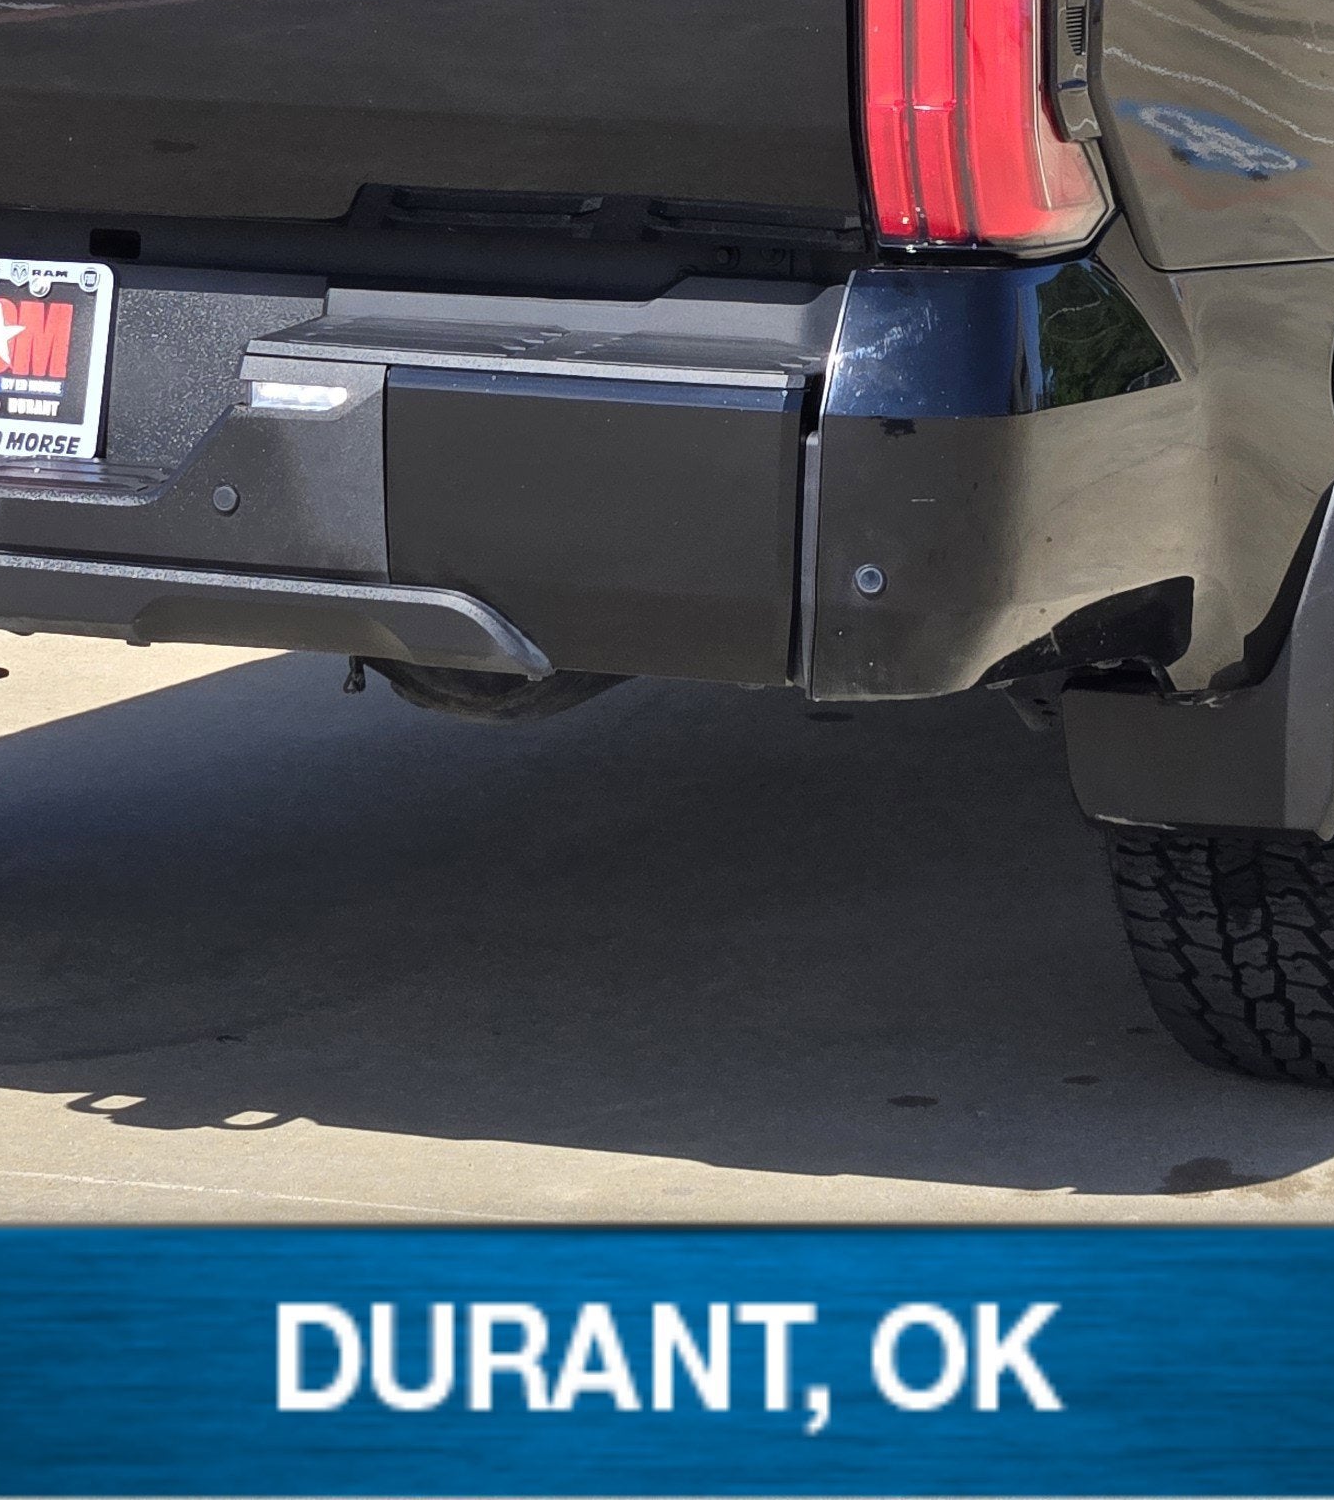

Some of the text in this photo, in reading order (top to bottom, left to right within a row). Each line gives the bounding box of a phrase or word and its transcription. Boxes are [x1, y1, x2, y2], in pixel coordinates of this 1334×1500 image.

[31, 269, 69, 278] RAM
[8, 397, 61, 417] DURANT
[6, 431, 81, 455] MORSE
